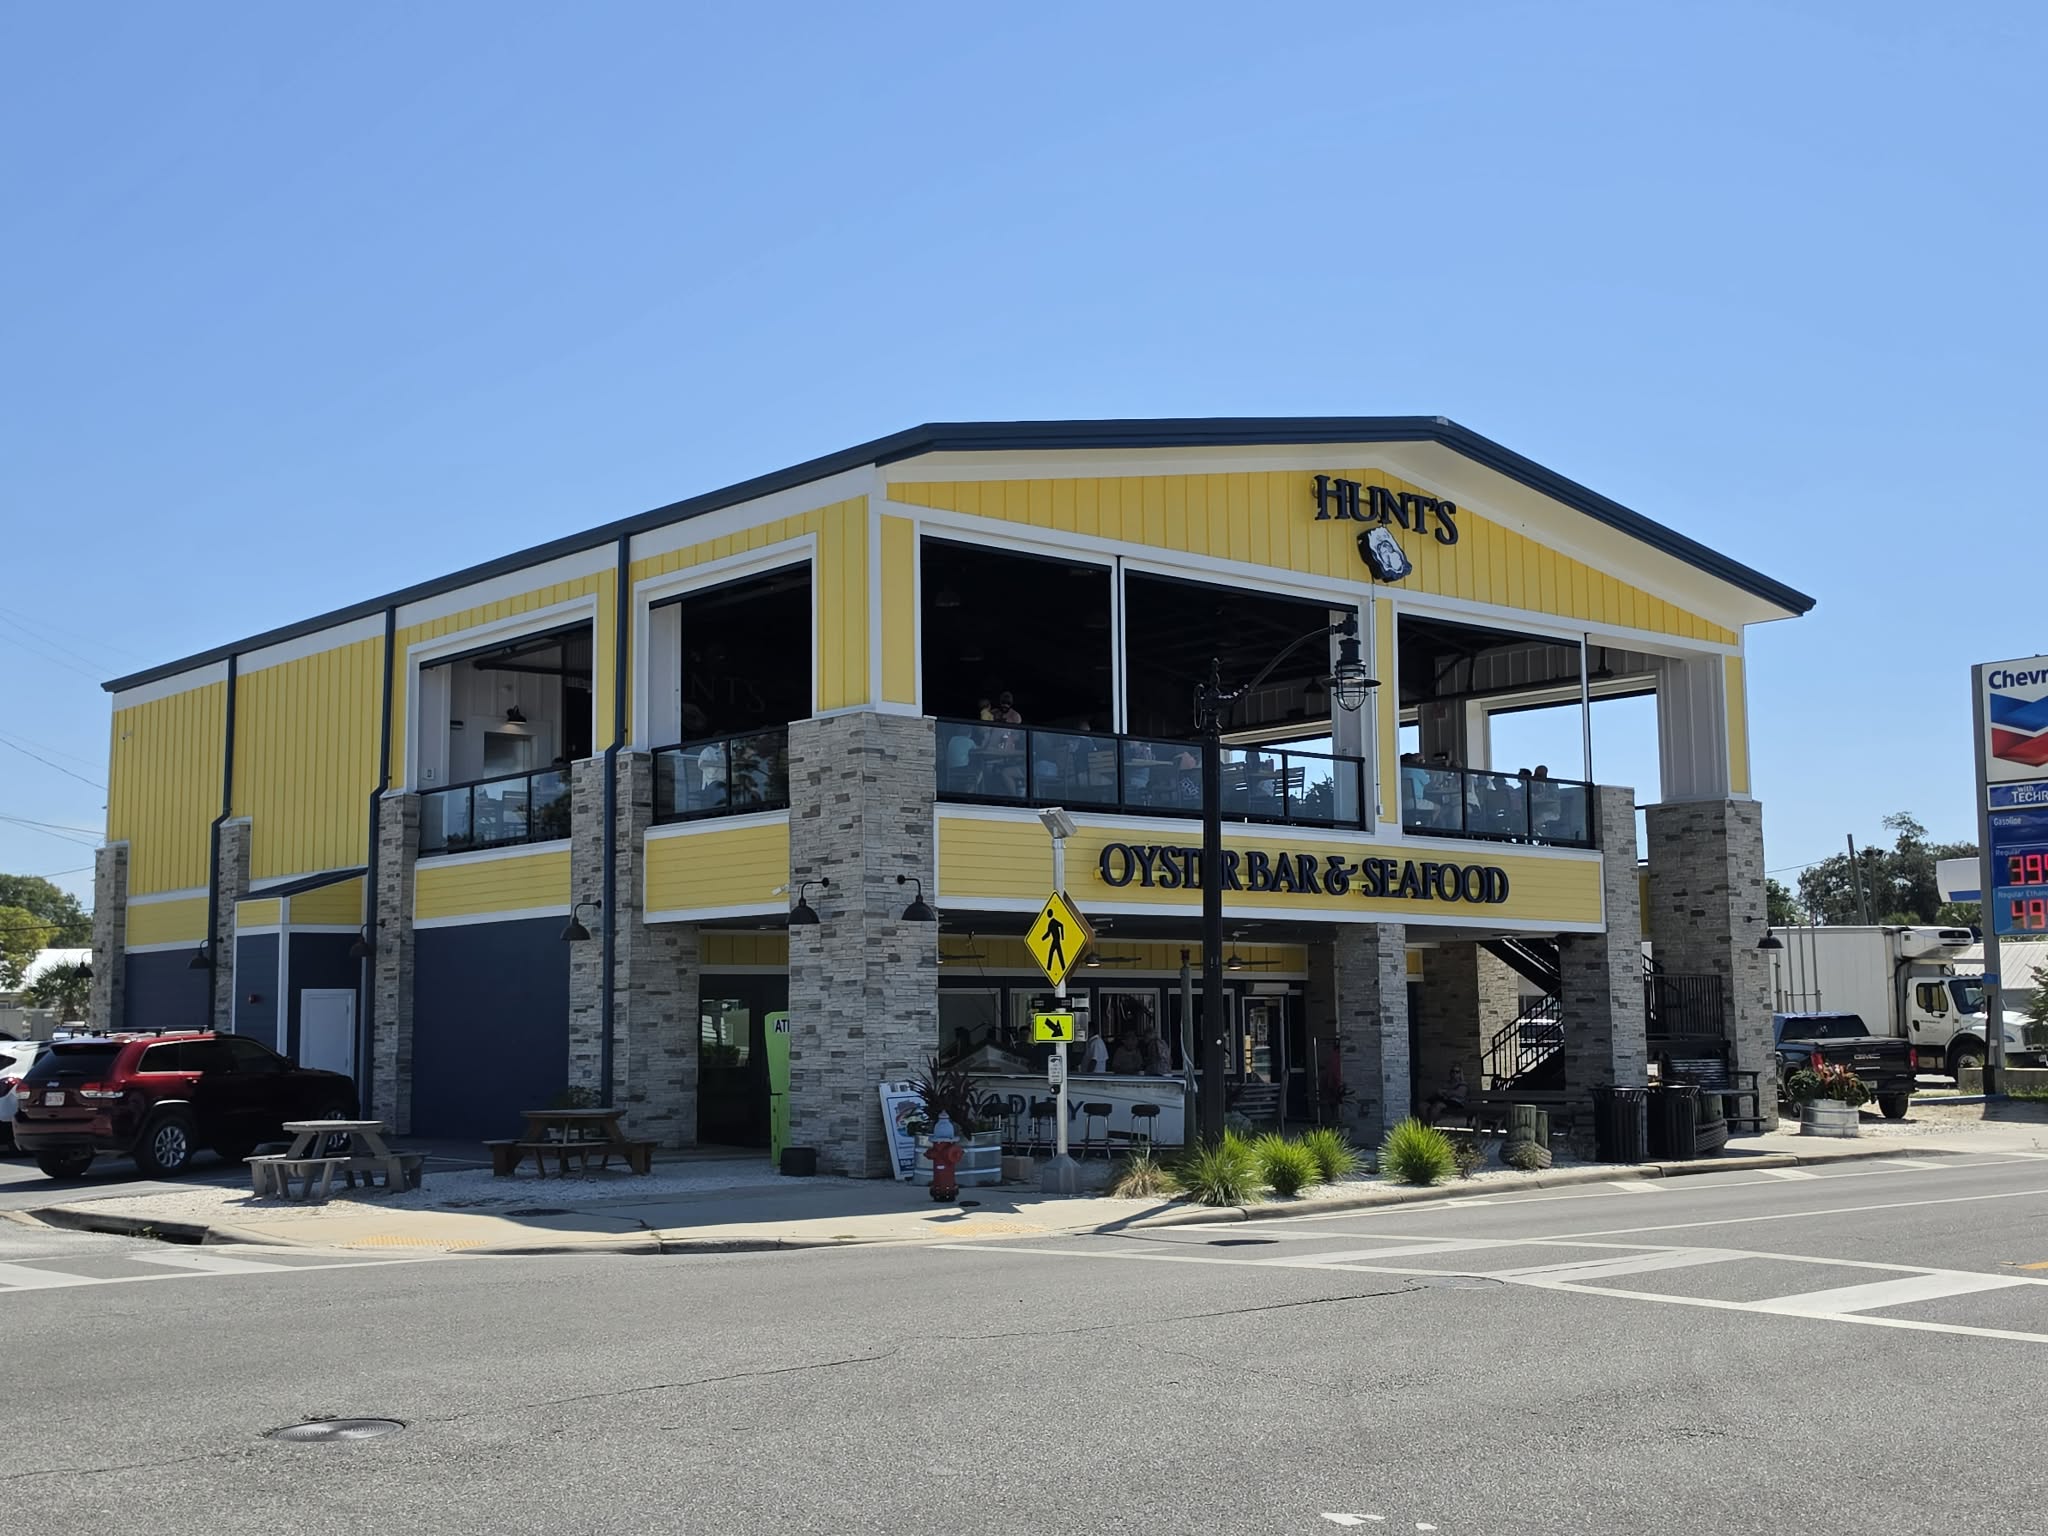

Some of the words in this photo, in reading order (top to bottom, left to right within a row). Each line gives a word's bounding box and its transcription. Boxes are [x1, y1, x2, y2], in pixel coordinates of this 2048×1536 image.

[1314, 475, 1458, 545] HUNT'S
[2017, 785, 2034, 793] with
[1993, 816, 2022, 826] Gasoline
[1245, 851, 1322, 894] BAR
[1324, 856, 1359, 896] &
[1362, 857, 1509, 903] SEAFOOD
[1997, 890, 2024, 899] Regular
[775, 1019, 790, 1033] AT
